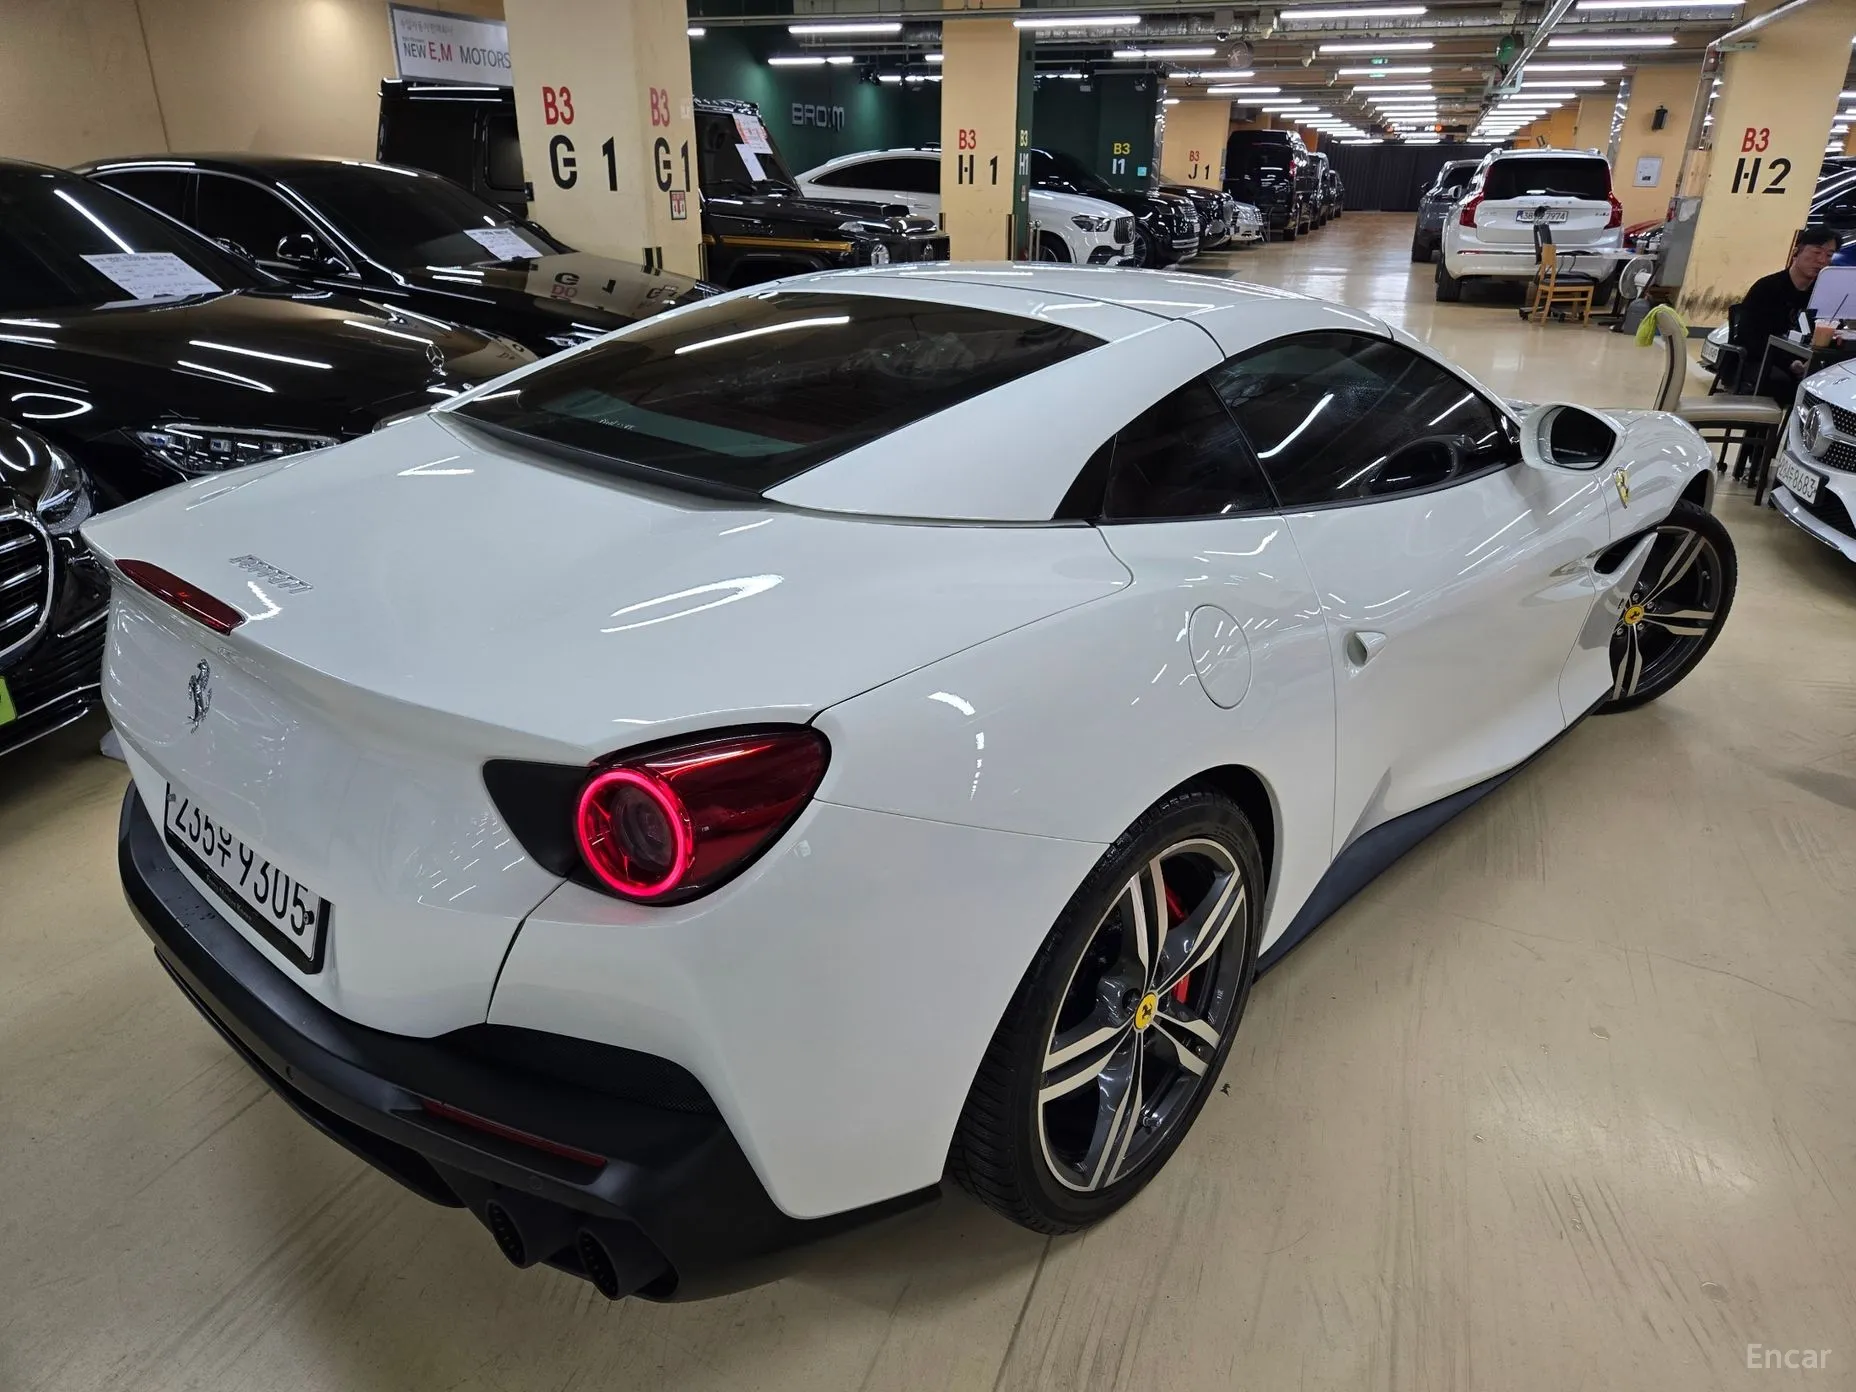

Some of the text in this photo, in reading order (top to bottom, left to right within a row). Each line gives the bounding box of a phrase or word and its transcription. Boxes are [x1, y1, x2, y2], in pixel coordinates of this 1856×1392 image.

[403, 43, 426, 58] NEW
[460, 46, 512, 69] MOTORS
[542, 86, 574, 125] B3
[650, 87, 670, 127] B3
[958, 129, 977, 150] B3
[1020, 129, 1029, 147] B3
[1113, 142, 1130, 155] B3
[1741, 127, 1770, 152] B3
[1018, 153, 1029, 175] H1
[1189, 150, 1200, 162] B3
